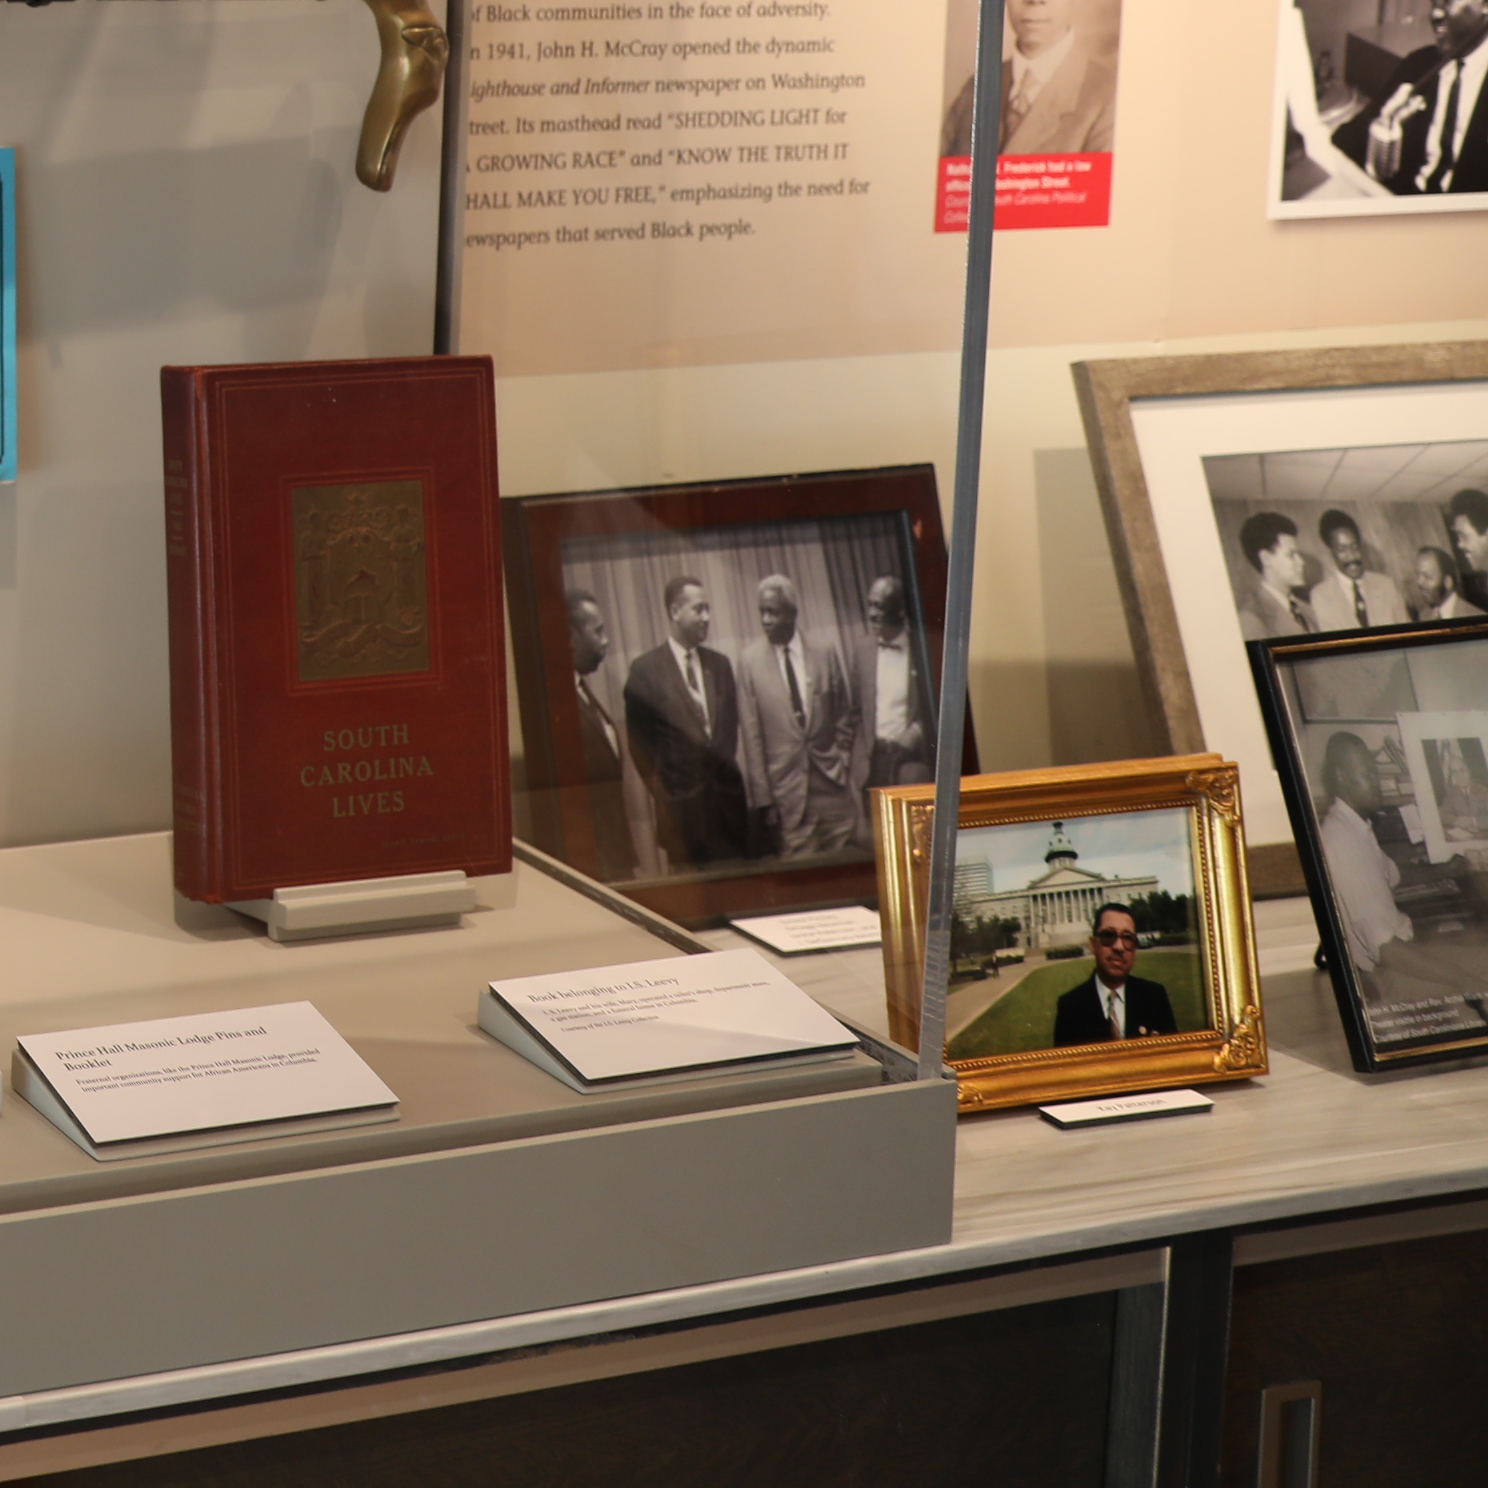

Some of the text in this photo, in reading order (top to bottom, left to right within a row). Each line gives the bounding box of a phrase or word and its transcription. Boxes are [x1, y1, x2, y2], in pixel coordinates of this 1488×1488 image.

[323, 723, 410, 752] SOUTH
[300, 755, 434, 787] CAROLINA
[332, 789, 406, 818] LIVES
[560, 985, 614, 1000] belonging
[55, 1034, 215, 1061] Prince Masonic Lodge
[63, 1058, 112, 1072] Booklet
